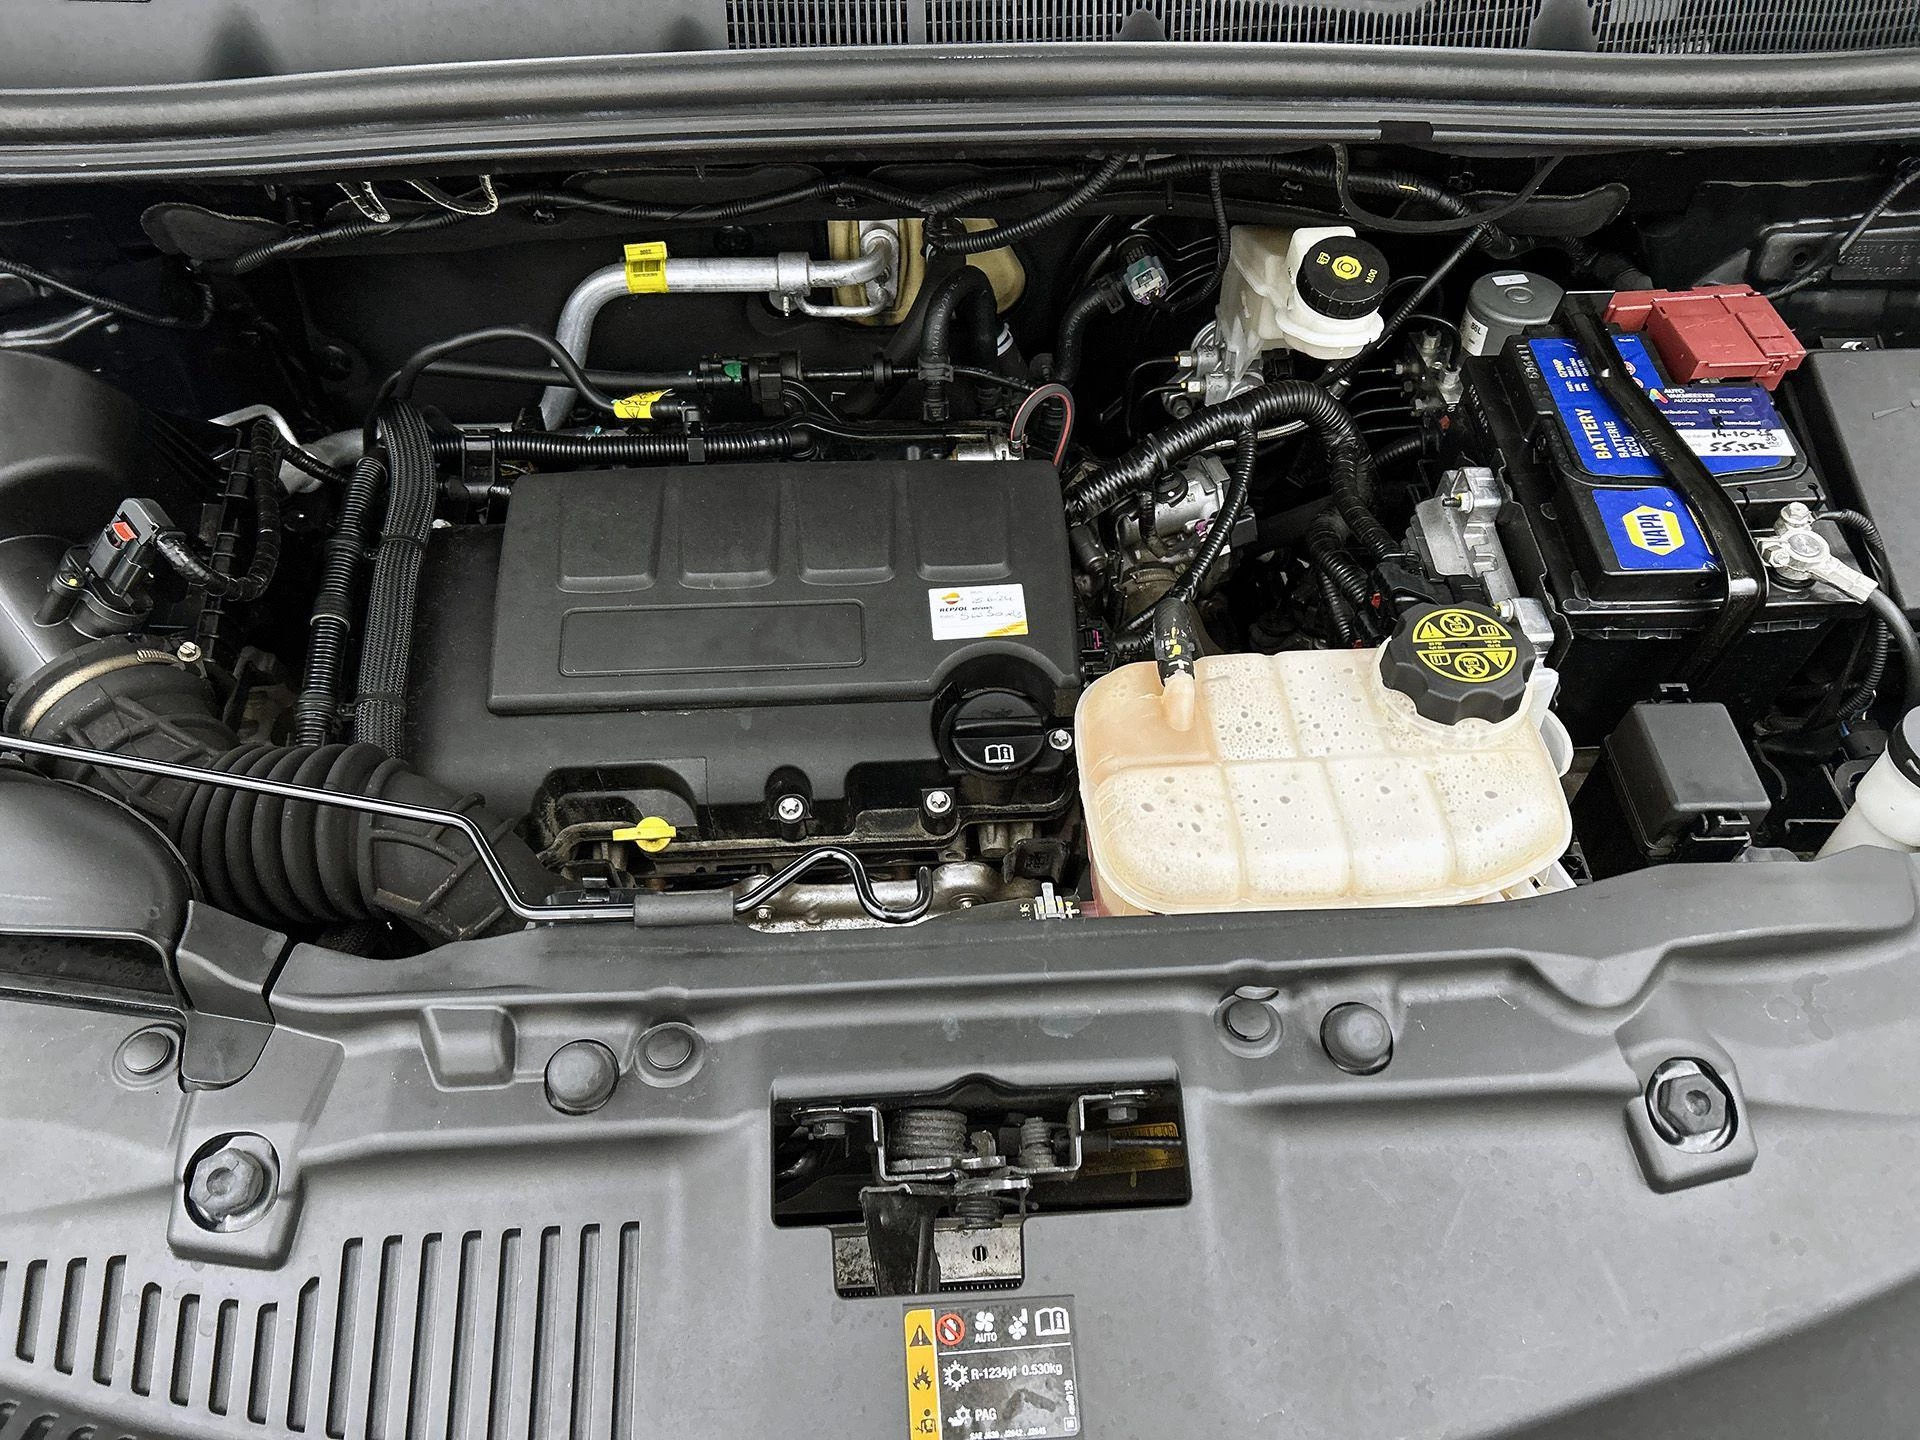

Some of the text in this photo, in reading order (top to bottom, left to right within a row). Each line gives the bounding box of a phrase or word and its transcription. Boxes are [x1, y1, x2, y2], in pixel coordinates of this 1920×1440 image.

[1574, 408, 1613, 460] BATTERY
[1603, 420, 1631, 459] BATTERIE
[1623, 435, 1644, 458] ACCU
[1642, 512, 1670, 548] NAPA
[974, 1331, 998, 1344] AUTO
[970, 1362, 1063, 1381] R-1234yf 0.530kg
[974, 1407, 998, 1422] PAG
